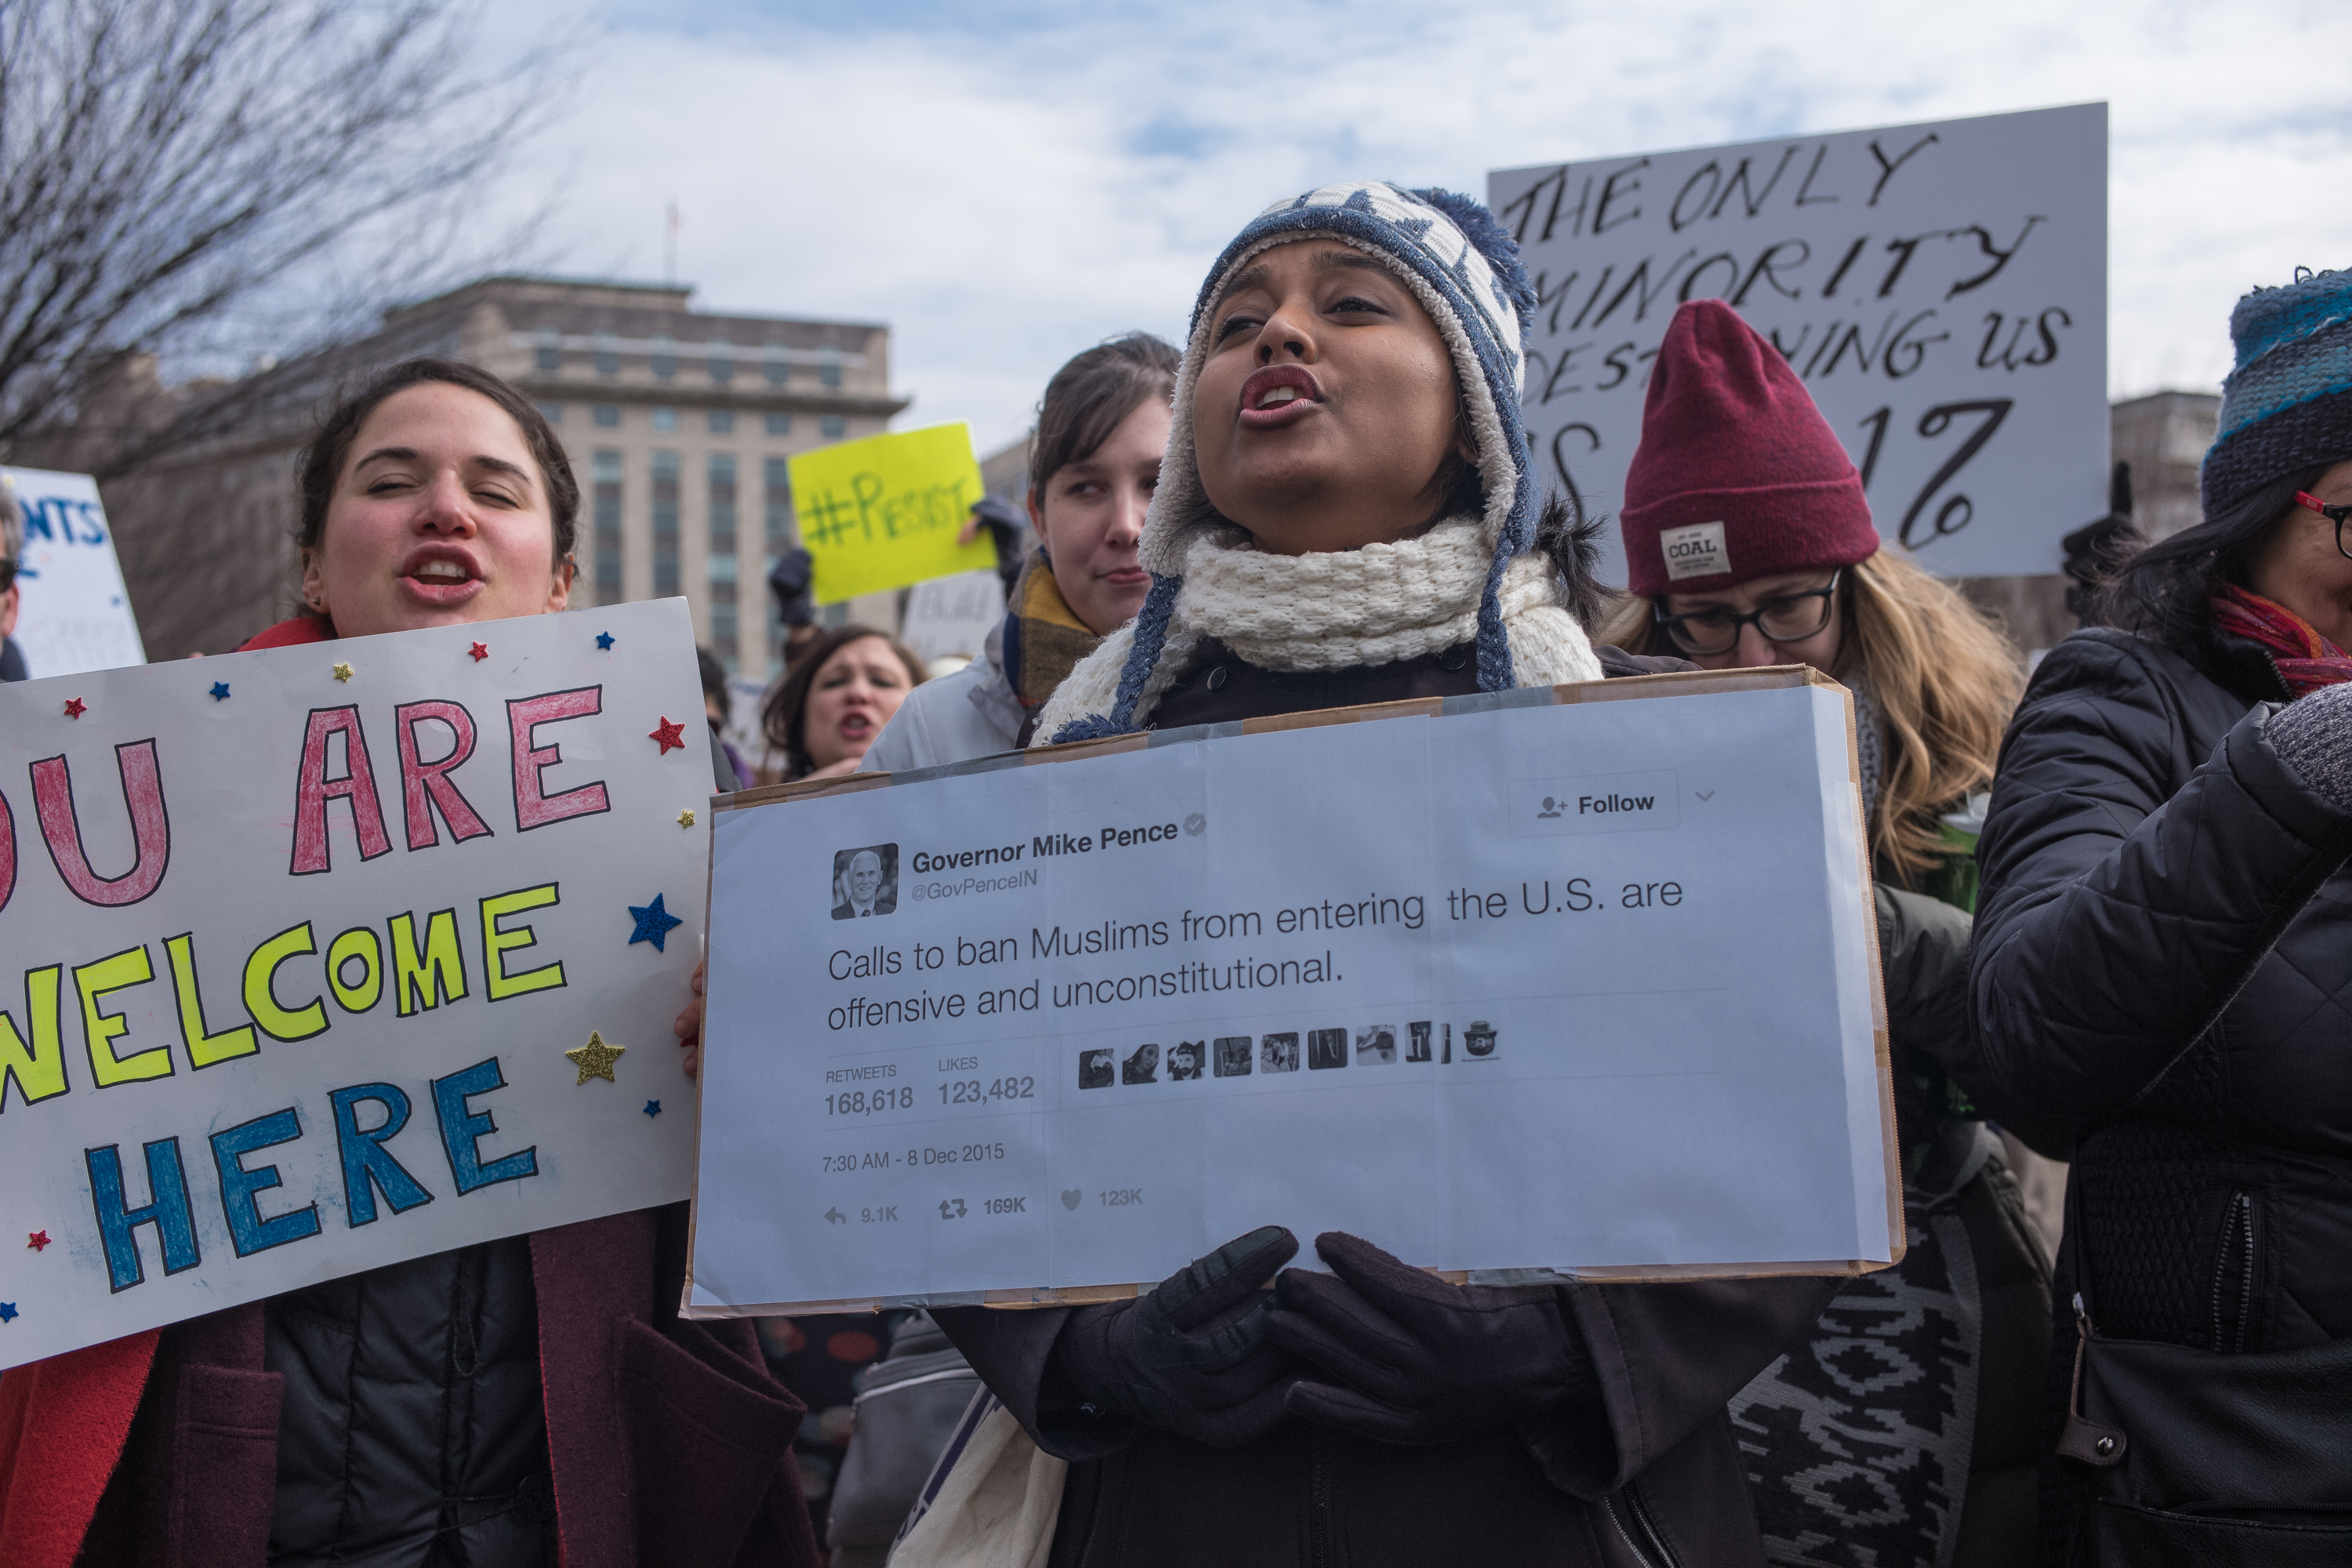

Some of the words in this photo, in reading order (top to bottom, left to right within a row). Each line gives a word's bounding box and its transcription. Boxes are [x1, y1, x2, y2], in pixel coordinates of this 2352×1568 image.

[1501, 156, 1652, 242] THE
[1669, 132, 1940, 234] ONLY
[1976, 306, 2073, 373] US
[1668, 539, 1717, 559] COAL
[289, 684, 612, 876] ARE
[1578, 794, 1654, 815] Follow
[913, 844, 1025, 873] Governor
[1033, 833, 1093, 858] Mike
[1101, 821, 1178, 849] Pence
[911, 868, 1038, 902] @GovPenceIN
[829, 945, 902, 981] Calls
[914, 941, 944, 971] to
[956, 936, 1018, 966] ban
[1032, 920, 1169, 959] Muslims
[1181, 909, 1261, 940] from
[1276, 892, 1425, 933] entering
[1446, 888, 1508, 920] the
[1522, 877, 1604, 915] U.S.
[1621, 880, 1683, 909] are
[828, 989, 966, 1031] offensive
[977, 978, 1040, 1015] and
[1053, 950, 1343, 1009] unconstitutional.
[826, 1064, 898, 1084] RETWEETS
[938, 1056, 978, 1073] LIKES
[825, 1086, 914, 1116] 168,618
[938, 1076, 1035, 1106] 123,482
[822, 1154, 858, 1173] 7:30
[862, 1152, 890, 1171] AM
[908, 1149, 917, 1167] 8
[924, 1147, 957, 1165] Dec
[962, 1142, 1004, 1163] 2015
[84, 1056, 539, 1294] HERE
[984, 1197, 1026, 1215] 169K
[1098, 1188, 1144, 1207] 123K
[861, 1206, 899, 1224] 9.1K
